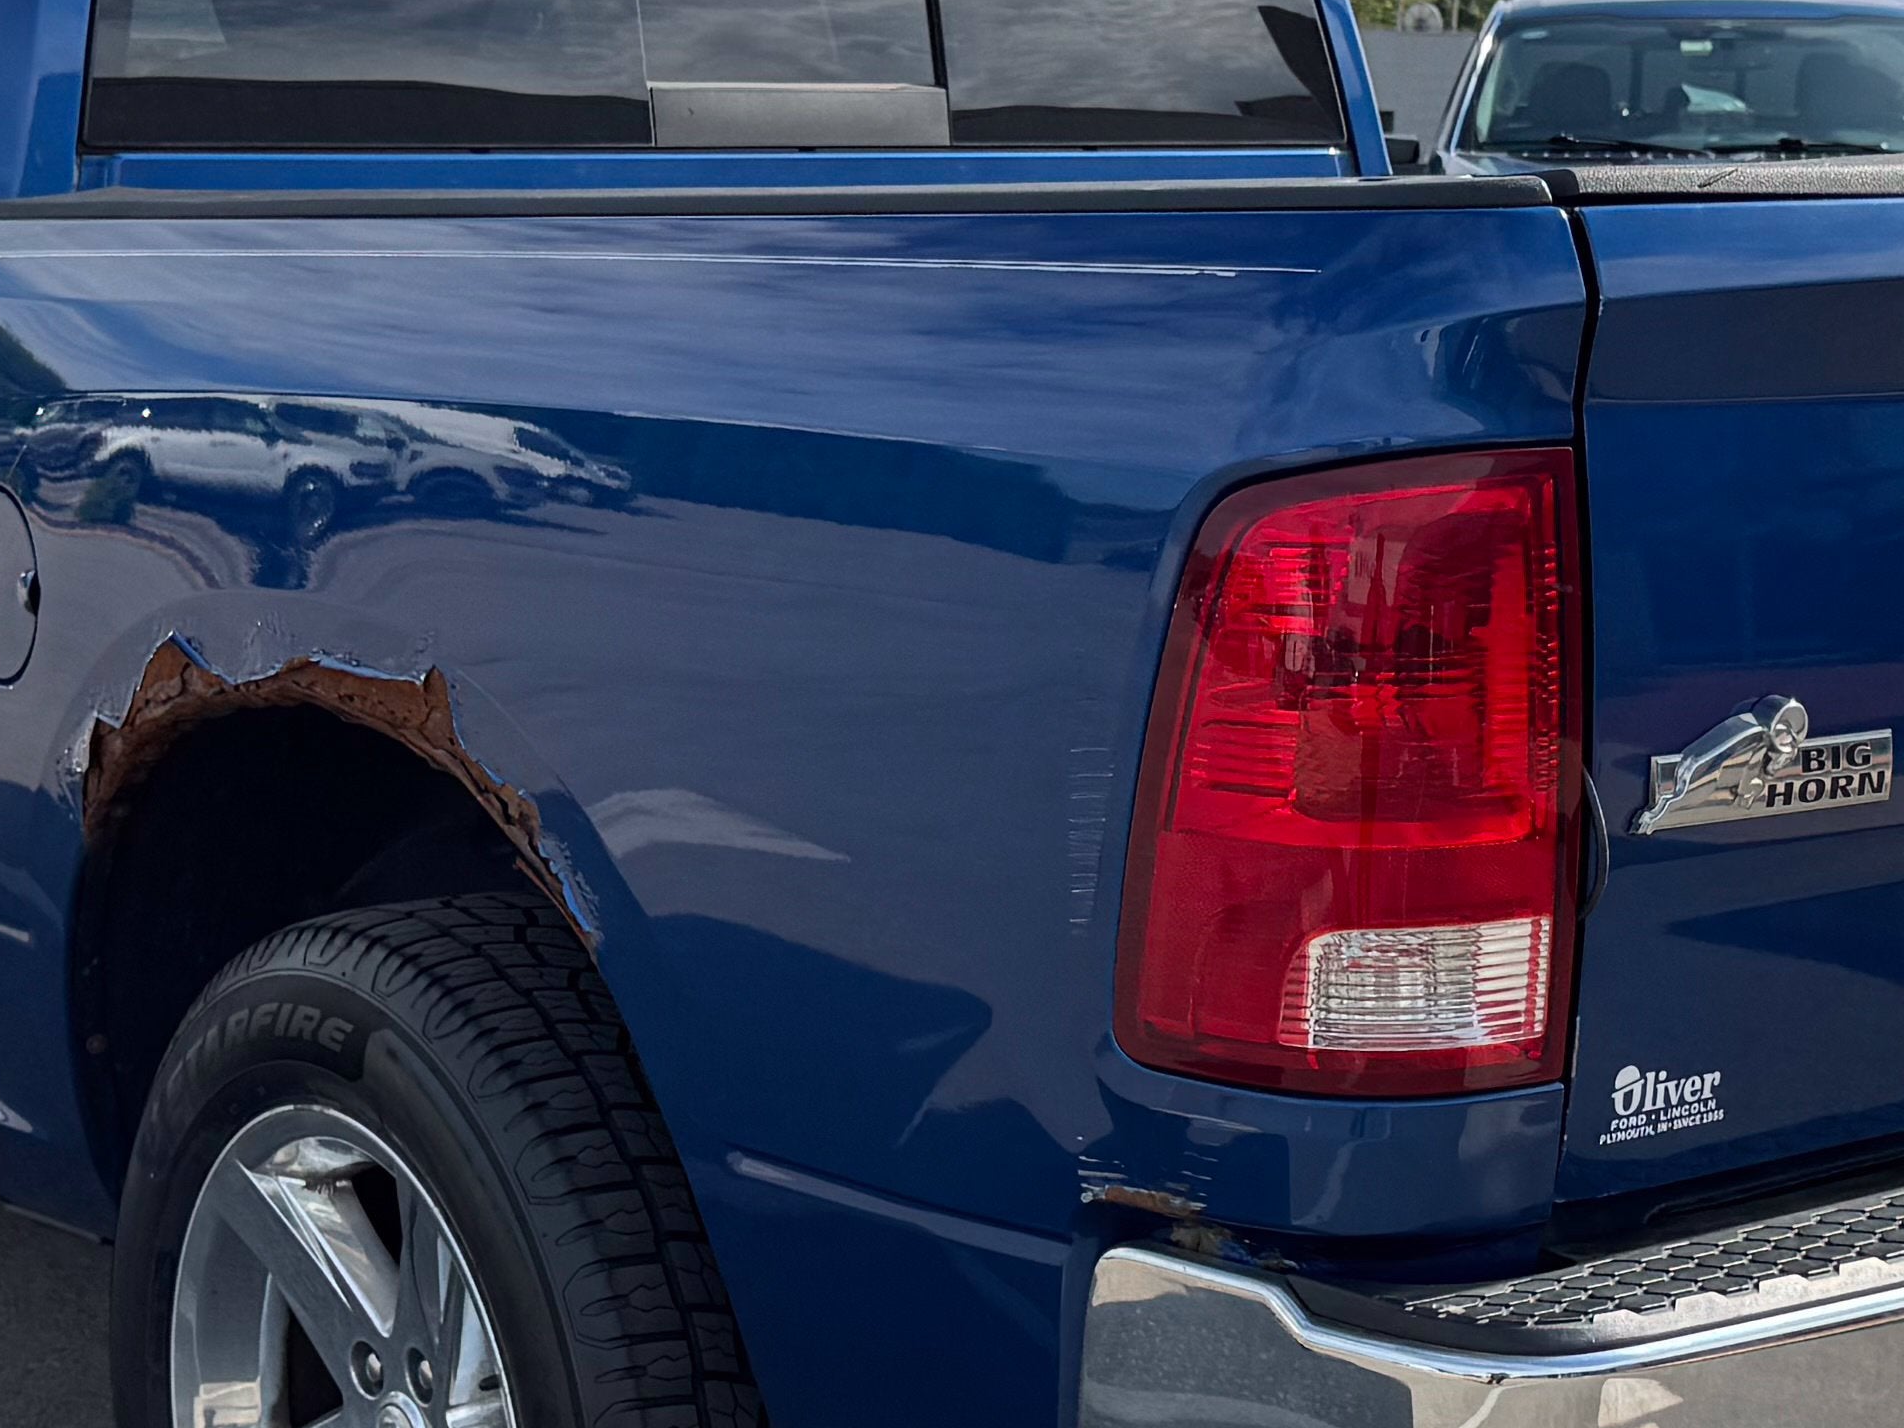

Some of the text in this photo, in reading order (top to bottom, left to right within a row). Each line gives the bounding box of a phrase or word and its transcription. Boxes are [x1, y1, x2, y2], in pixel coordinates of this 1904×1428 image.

[1801, 742, 1871, 773] BIG
[1765, 770, 1886, 808] HORN
[1611, 1065, 1721, 1116] Oliver
[1610, 1099, 1717, 1131] FORD LINCOLN
